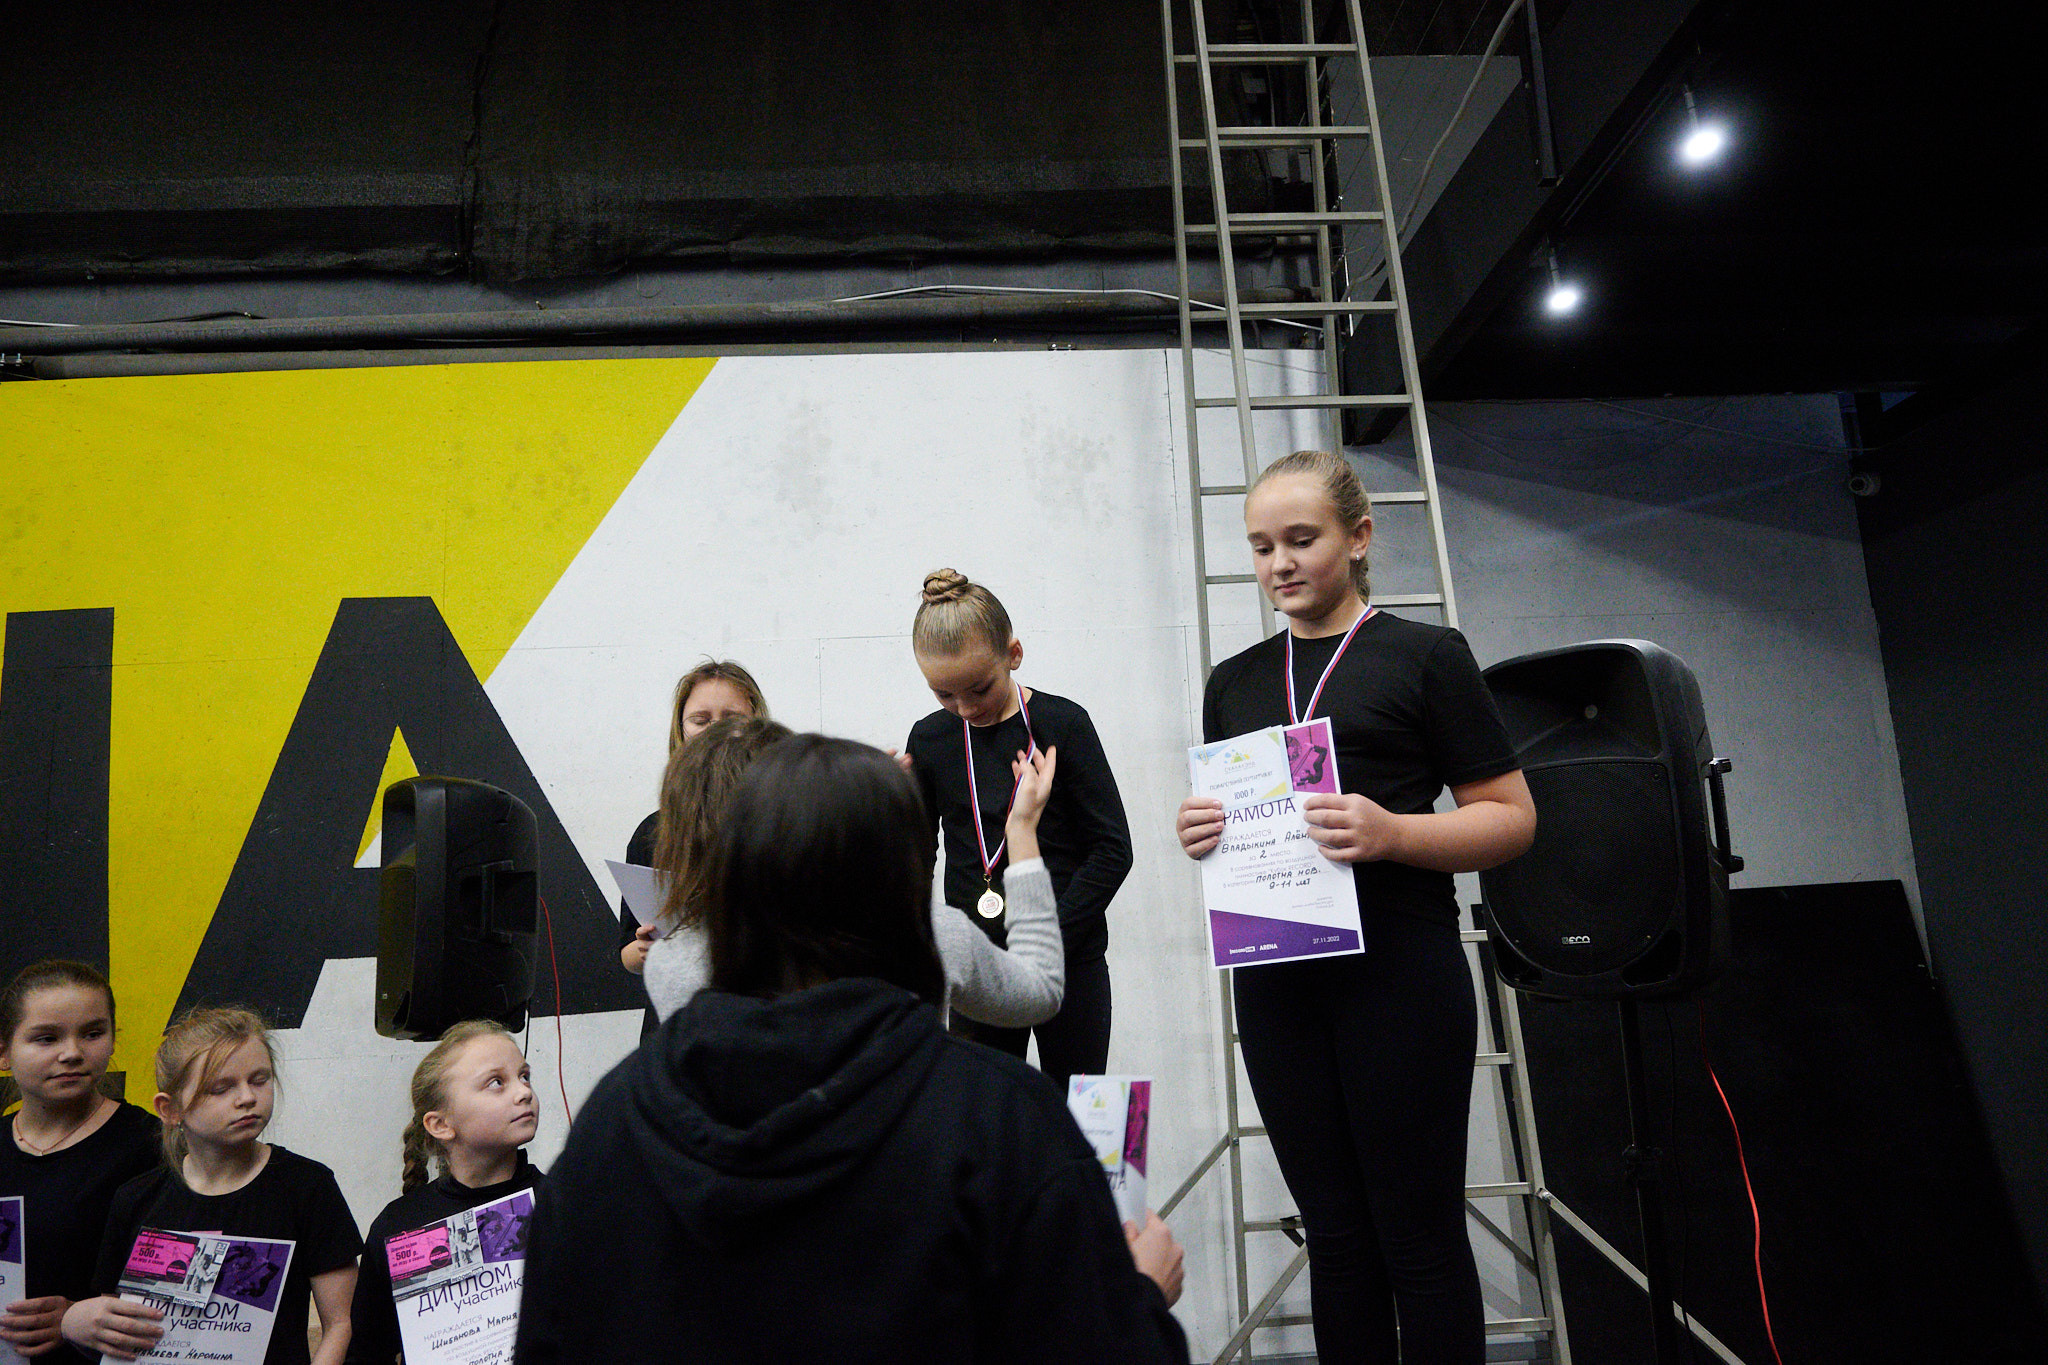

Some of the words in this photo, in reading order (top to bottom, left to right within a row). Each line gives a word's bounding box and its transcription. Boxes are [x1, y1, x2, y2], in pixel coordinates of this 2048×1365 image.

[1234, 789, 1249, 800] 1000
[1224, 797, 1297, 825] РАМОТА
[1285, 830, 1310, 843] Алён
[1259, 849, 1267, 859] 2
[1259, 943, 1278, 951] ARENA
[138, 1247, 155, 1258] 500
[395, 1249, 411, 1261] 500
[418, 1263, 512, 1317] ДИПЛОМ
[453, 1276, 523, 1314] участник
[170, 1317, 252, 1333] участника
